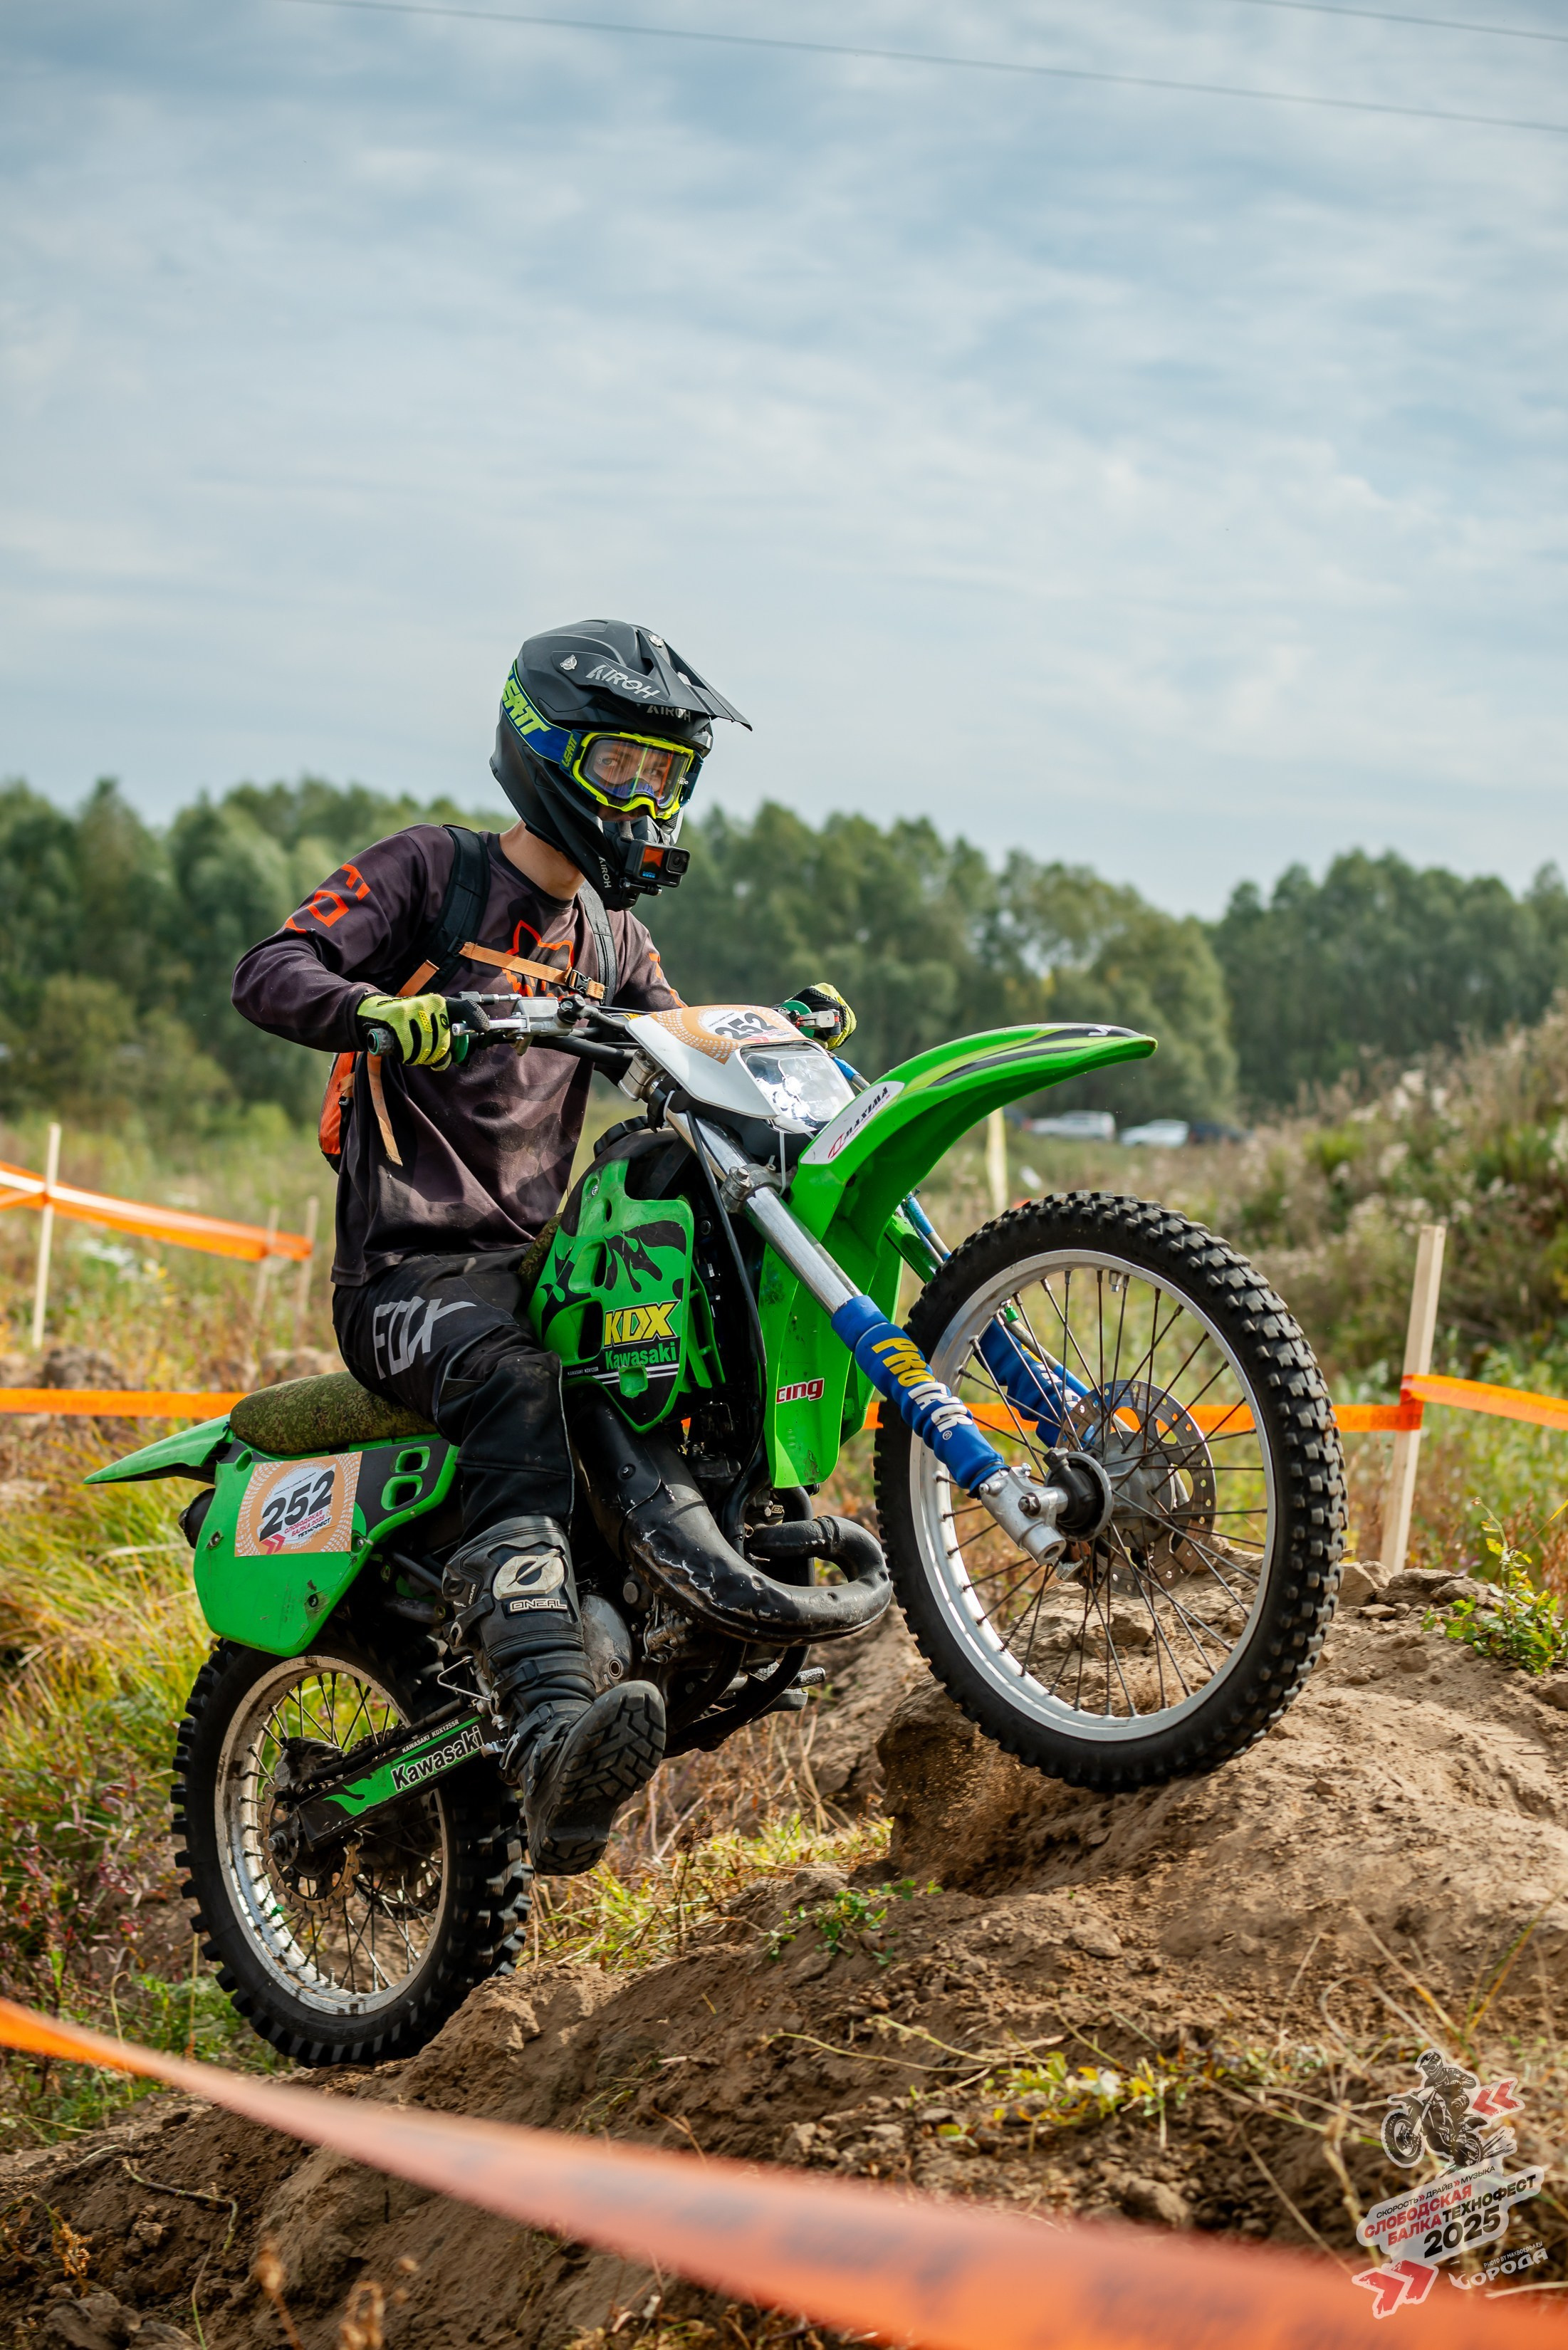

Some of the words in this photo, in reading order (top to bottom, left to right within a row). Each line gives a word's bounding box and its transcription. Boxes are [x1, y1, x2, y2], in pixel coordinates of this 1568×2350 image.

[585, 664, 660, 699] AIROH
[598, 856, 612, 888] AIROH
[714, 1013, 779, 1040] 252
[373, 1296, 476, 1379] FOX
[604, 1300, 679, 1347] KDX
[605, 1342, 676, 1369] Kawasaki
[259, 1471, 335, 1542] 252
[285, 1510, 323, 1534] СЛОБОДСКАЯ
[292, 1523, 310, 1537] БАЛКА
[402, 1735, 430, 1753] KAWASAKI
[432, 1719, 459, 1738] KDX125SR
[391, 1725, 484, 1791] Kawasaki
